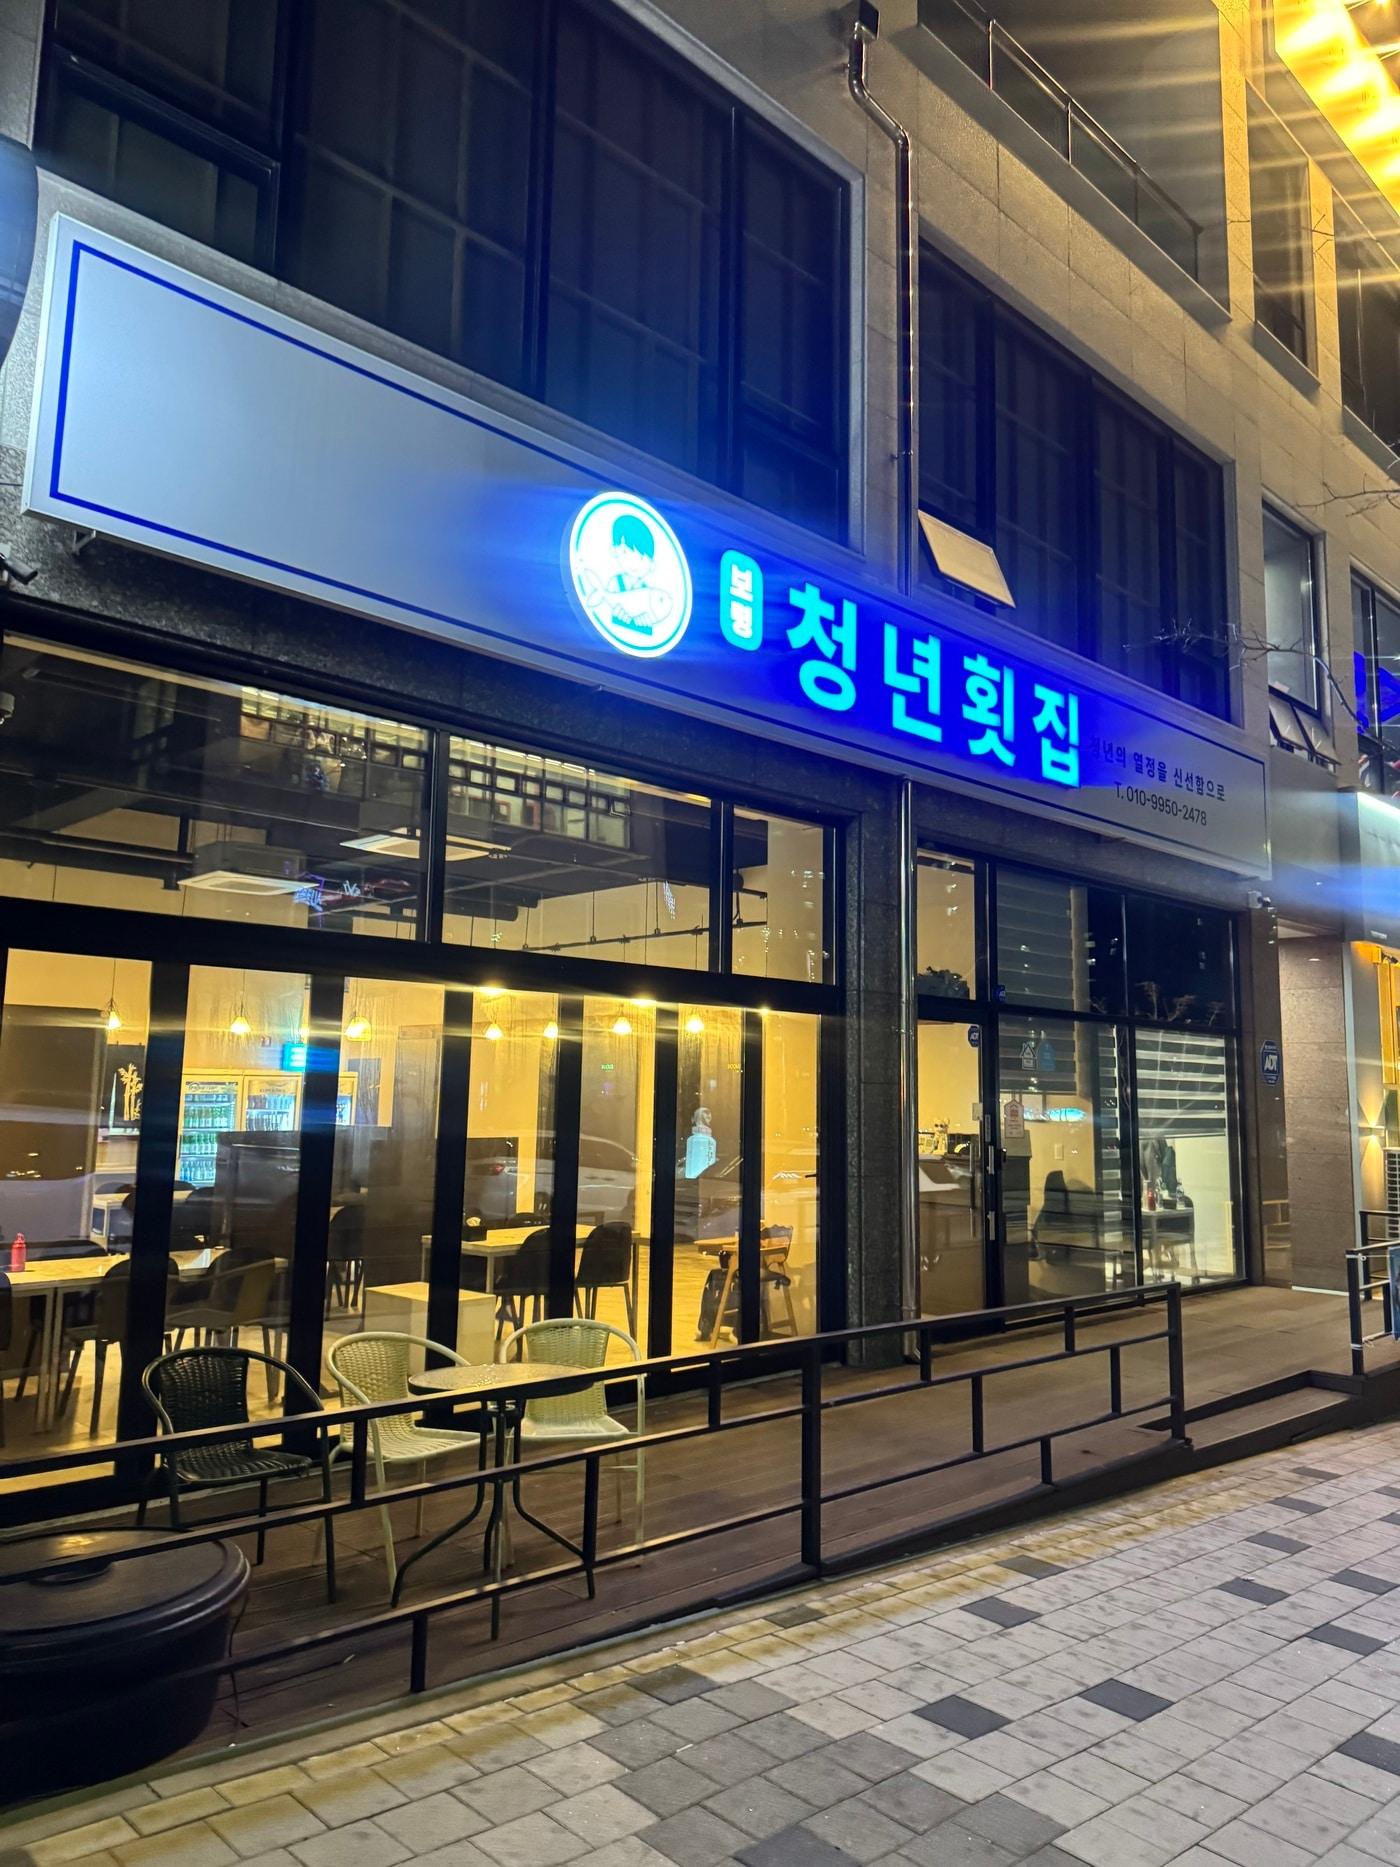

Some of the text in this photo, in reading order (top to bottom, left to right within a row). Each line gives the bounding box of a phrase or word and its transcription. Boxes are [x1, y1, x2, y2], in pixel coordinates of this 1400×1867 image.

[786, 582, 1081, 788] 청년횟집
[1133, 751, 1168, 783] 열정을
[1173, 767, 1226, 802] 신선함으로
[1264, 1054, 1278, 1071] ADT
